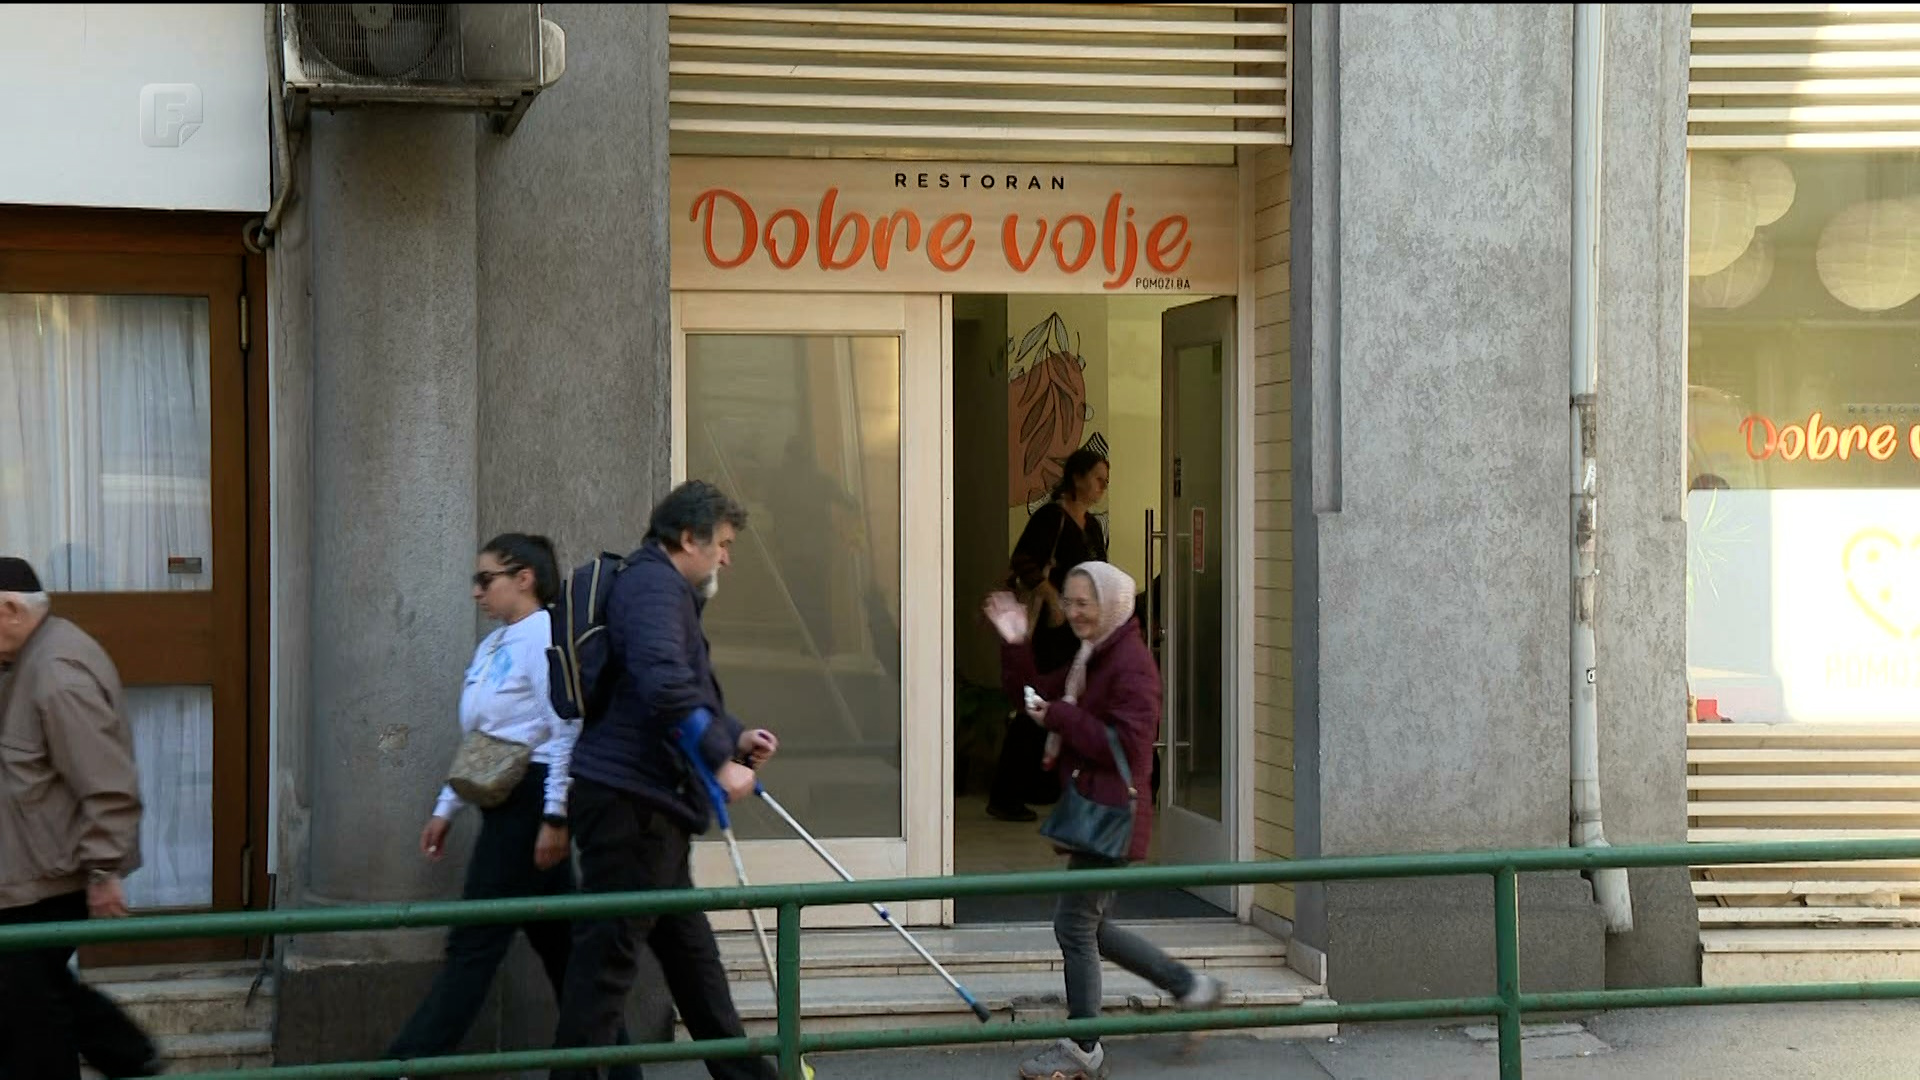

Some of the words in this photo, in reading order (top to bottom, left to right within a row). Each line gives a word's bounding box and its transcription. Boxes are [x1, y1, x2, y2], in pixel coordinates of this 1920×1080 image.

[894, 173, 1065, 190] RESTORAN
[690, 187, 976, 272] Dobre
[1002, 193, 1193, 290] volje
[1740, 412, 1898, 461] Dobre
